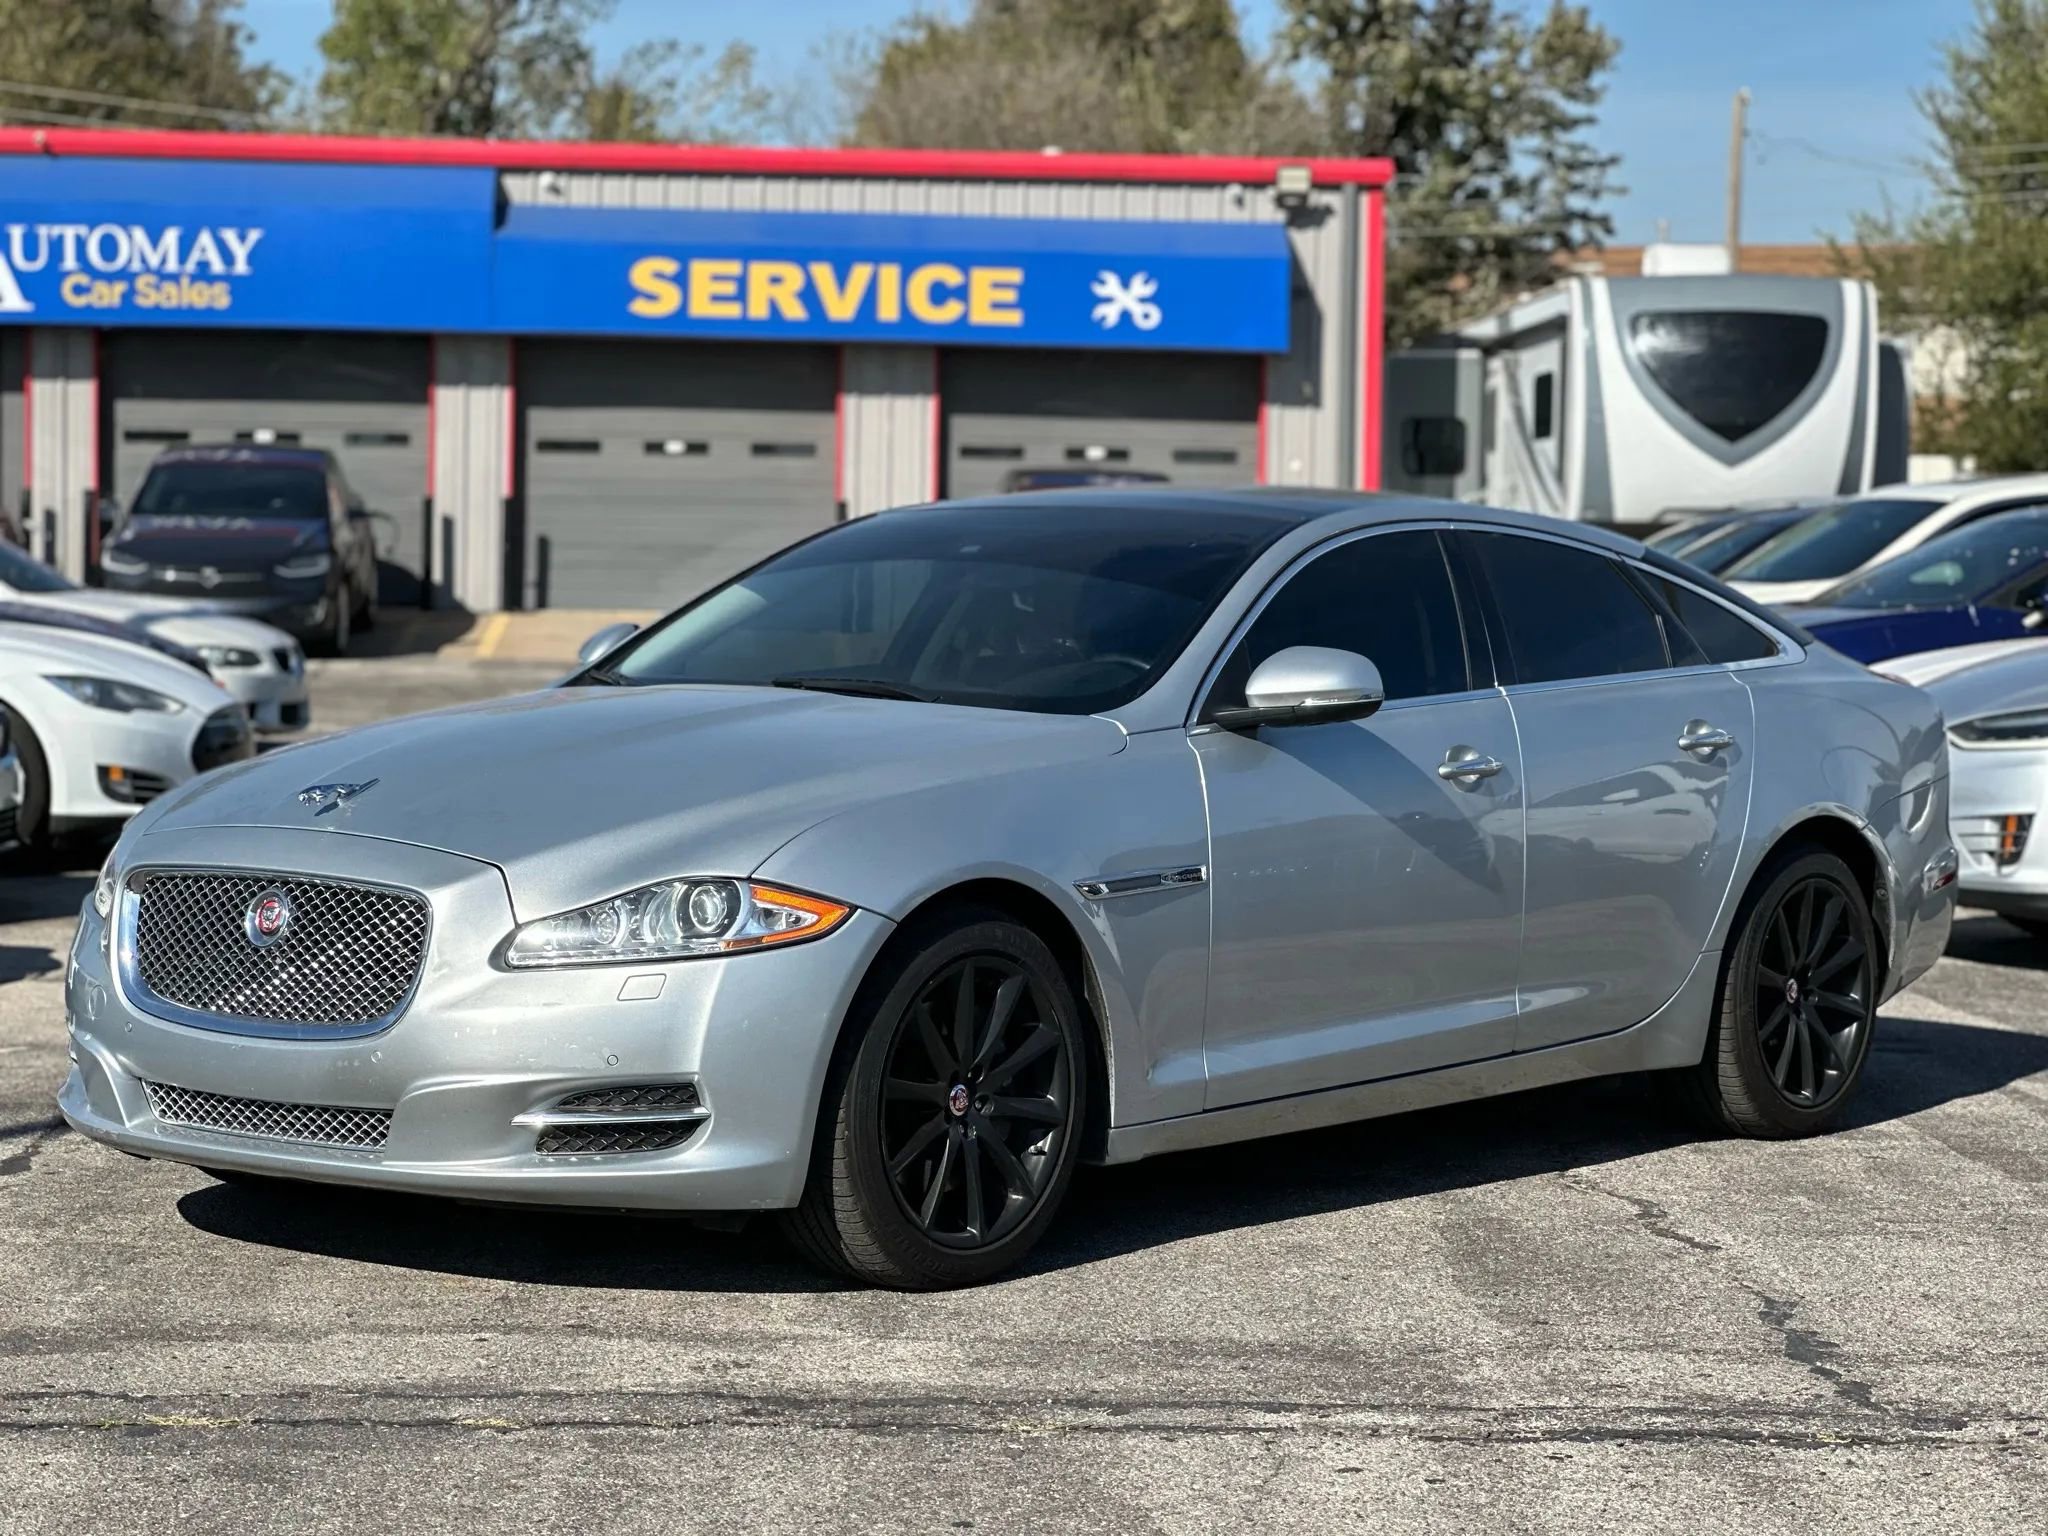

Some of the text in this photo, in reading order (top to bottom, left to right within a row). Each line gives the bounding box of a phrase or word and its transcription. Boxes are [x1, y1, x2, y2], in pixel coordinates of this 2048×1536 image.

[61, 273, 232, 310] Car Sales
[627, 256, 1024, 326] SERVICE
